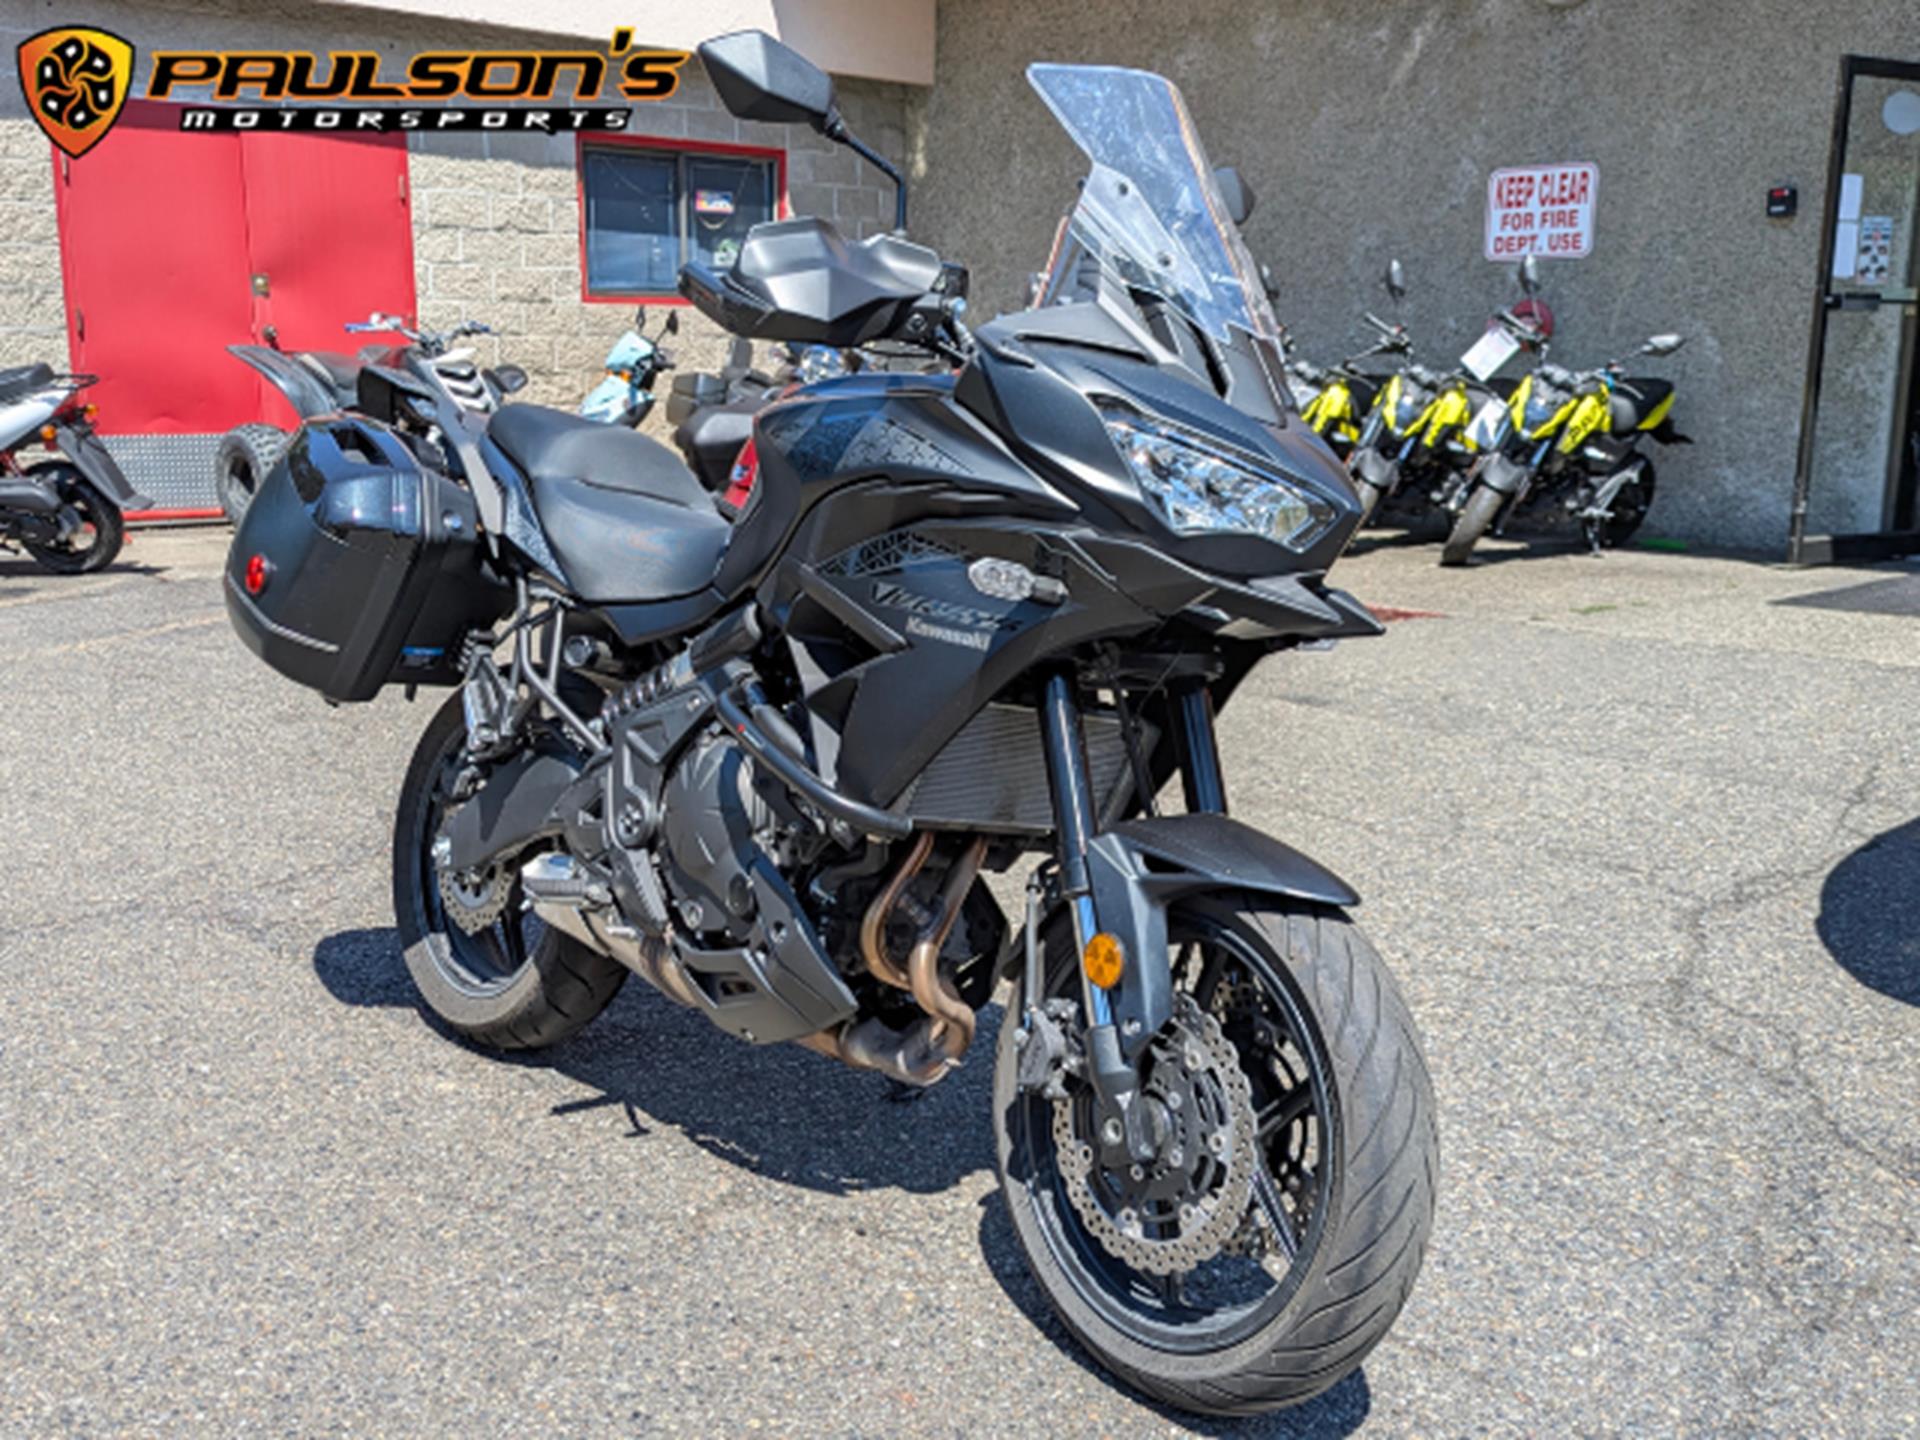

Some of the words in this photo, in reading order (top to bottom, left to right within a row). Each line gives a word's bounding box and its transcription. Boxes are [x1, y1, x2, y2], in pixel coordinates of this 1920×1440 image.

[1495, 175, 1535, 209] KEEP
[1539, 170, 1589, 207] CLEAR
[1500, 212, 1534, 231] FOR
[1540, 208, 1580, 229] FIRE
[1493, 233, 1543, 254] DEPT.
[1547, 231, 1584, 252] USE
[906, 614, 993, 651] Kawasaki
